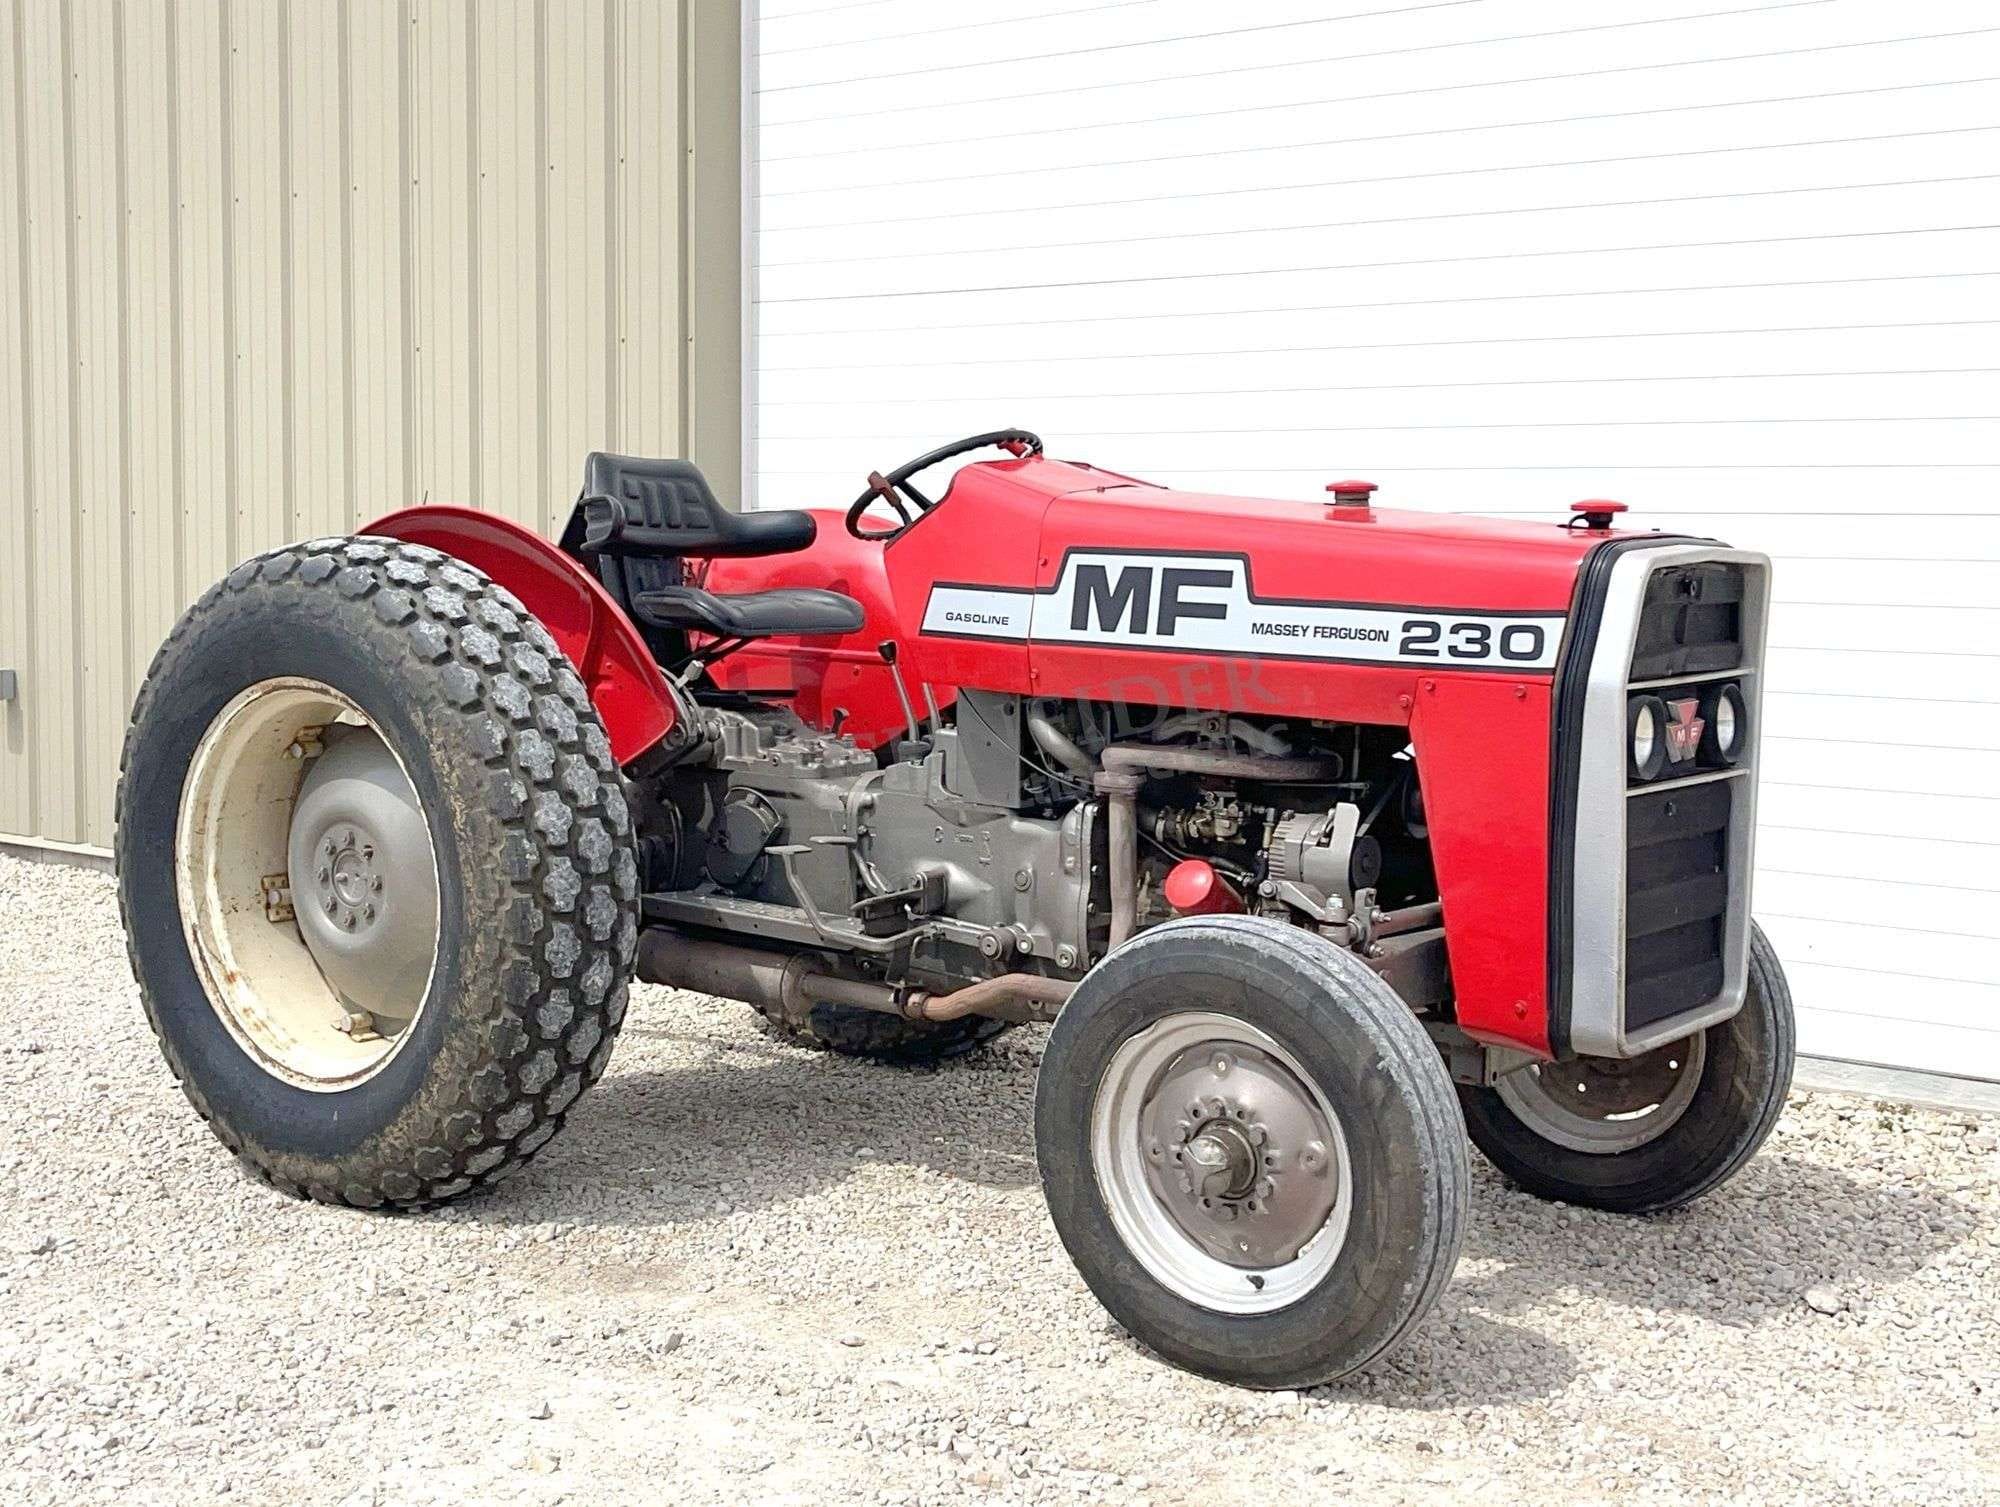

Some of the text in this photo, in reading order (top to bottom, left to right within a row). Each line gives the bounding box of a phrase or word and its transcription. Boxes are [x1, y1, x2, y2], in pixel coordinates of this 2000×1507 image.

[1070, 564, 1234, 636] MF
[945, 611, 1010, 626] GASOLINE
[1250, 622, 1390, 643] MASSEY FERGUSON
[1398, 619, 1546, 661] 230
